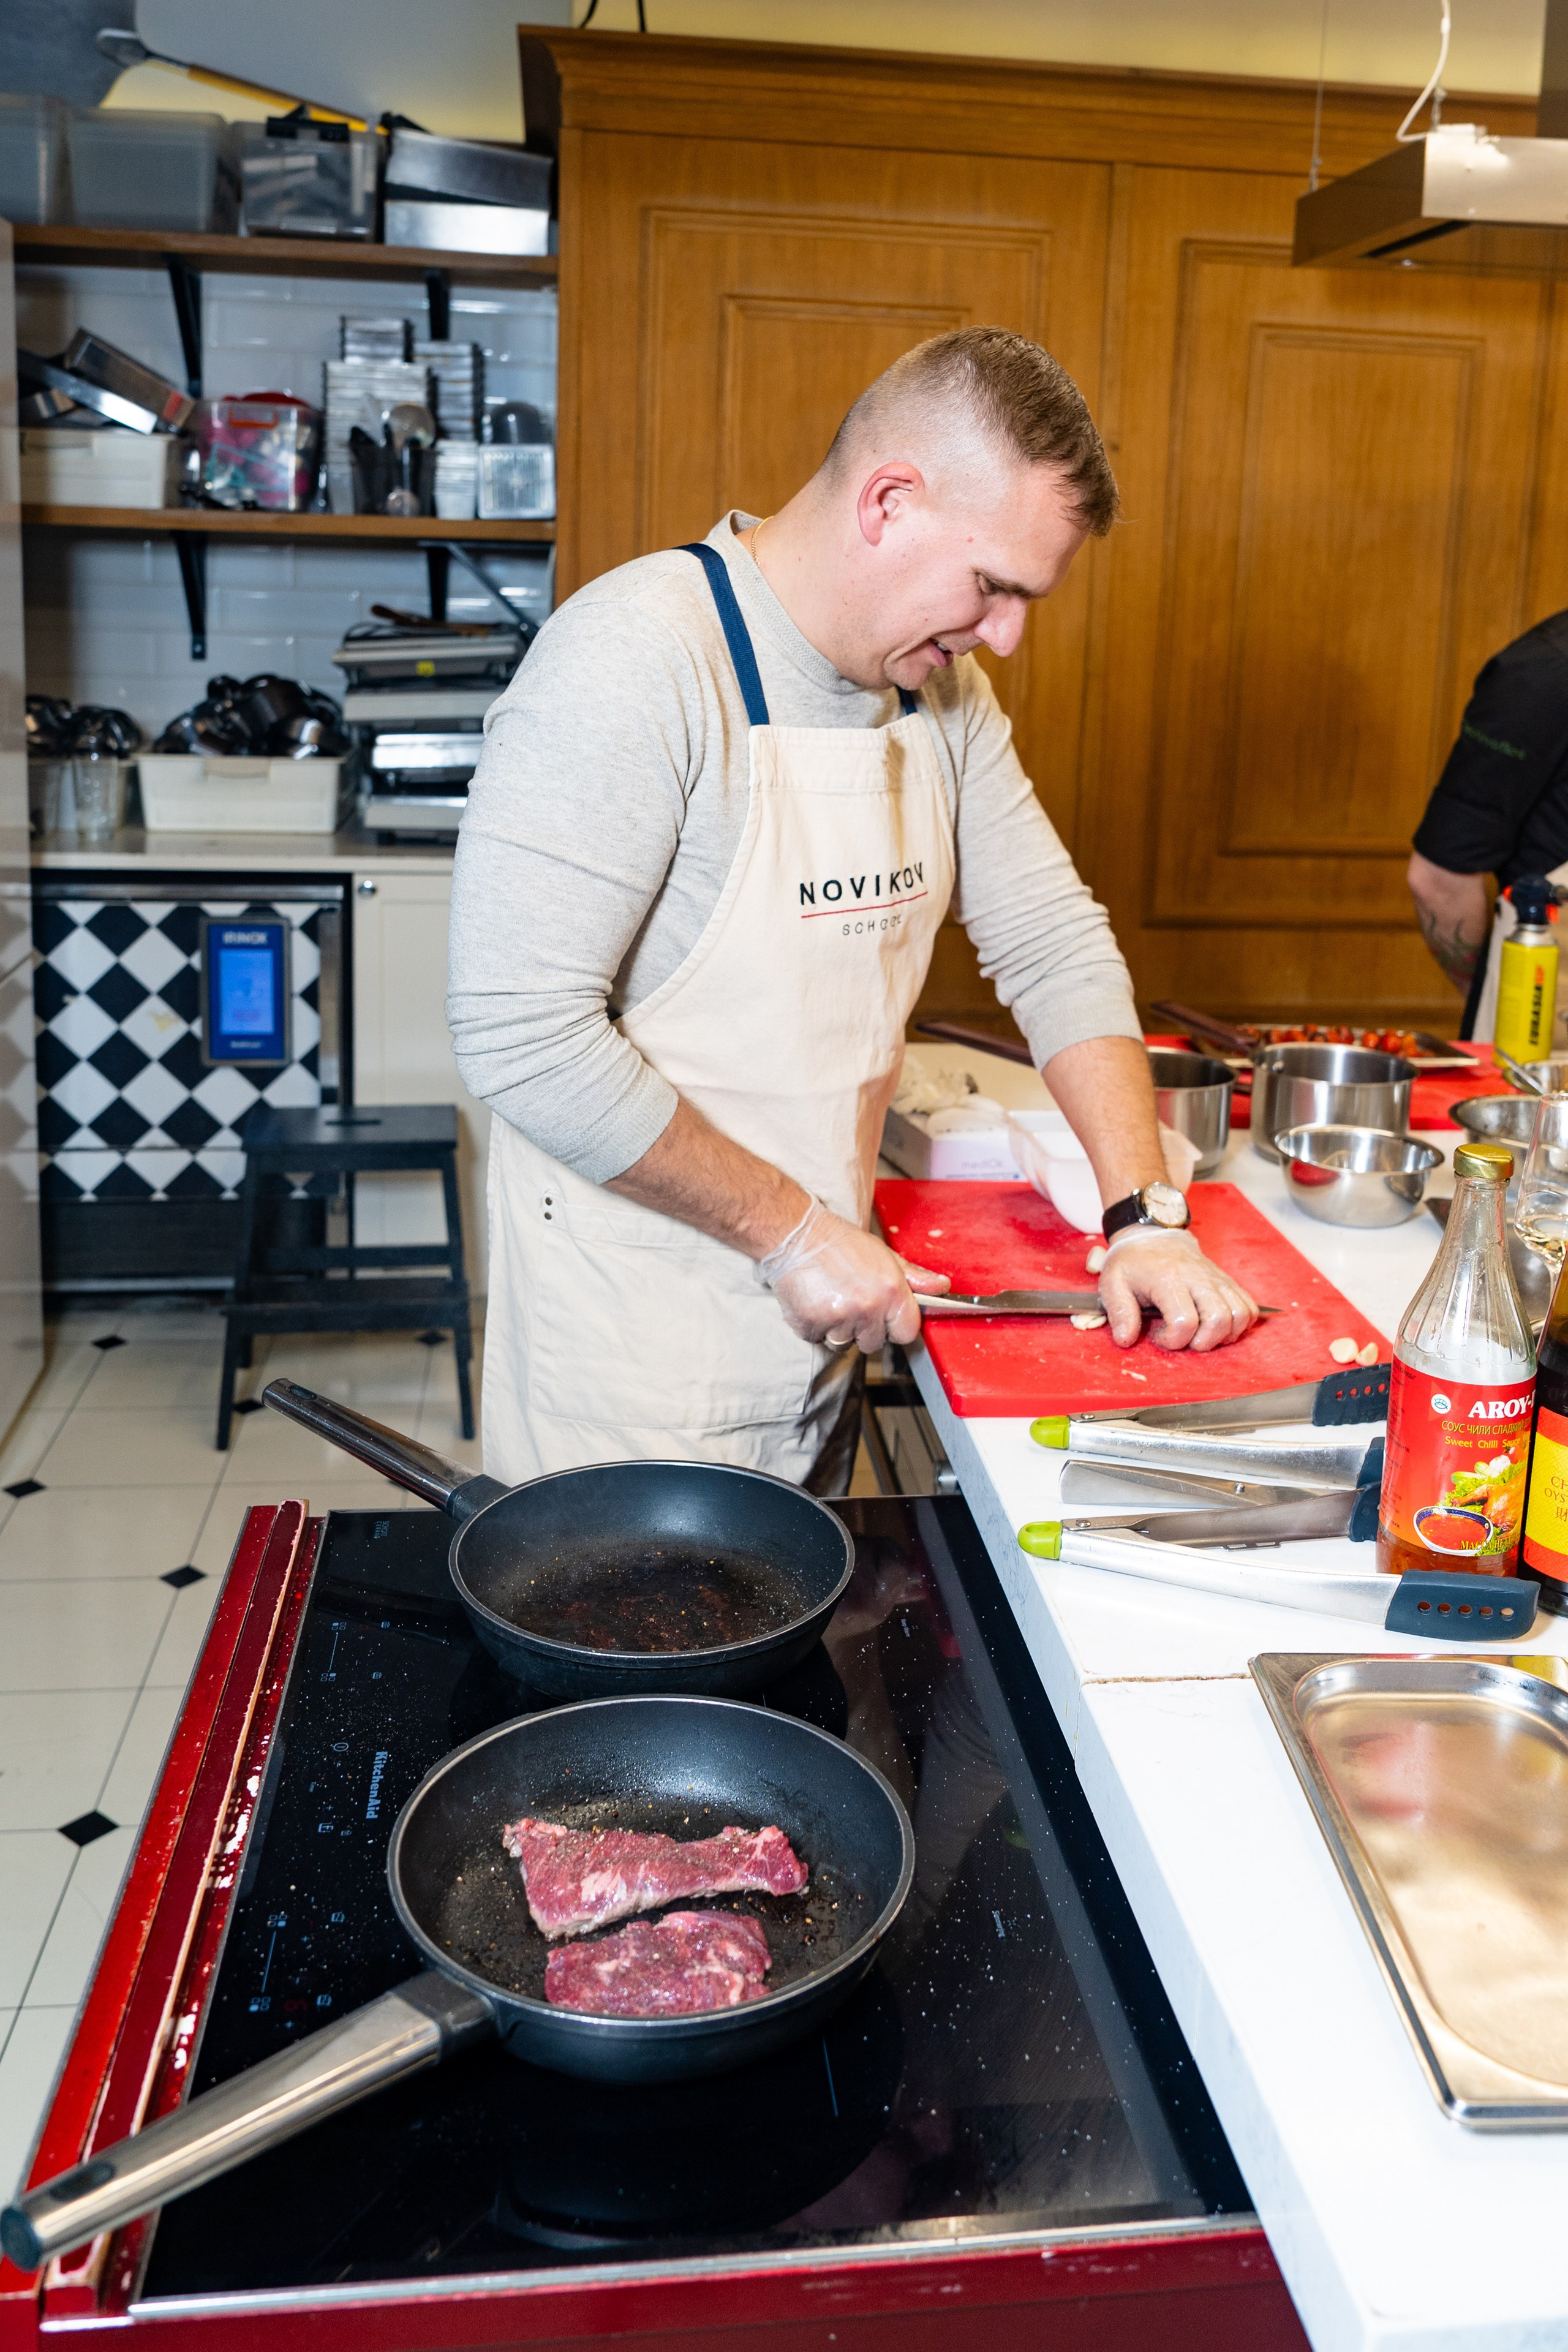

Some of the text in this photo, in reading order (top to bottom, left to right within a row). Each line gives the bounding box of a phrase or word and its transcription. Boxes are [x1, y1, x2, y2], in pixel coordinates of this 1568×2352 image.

[799, 862, 924, 905] NOVIKOV
[1442, 1420, 1465, 1434] СОУС
[1467, 1424, 1491, 1436] ЧИЛИ
[1492, 1419, 1525, 1436] СЛАДКИЙ
[1445, 1436, 1473, 1449] Sweet
[1477, 1440, 1498, 1449] Chilli
[1502, 1438, 1521, 1448] Sauce
[1544, 1487, 1568, 1504] OYS
[1460, 1540, 1492, 1550] МАССА
[366, 1751, 388, 1819] KitchenAid
